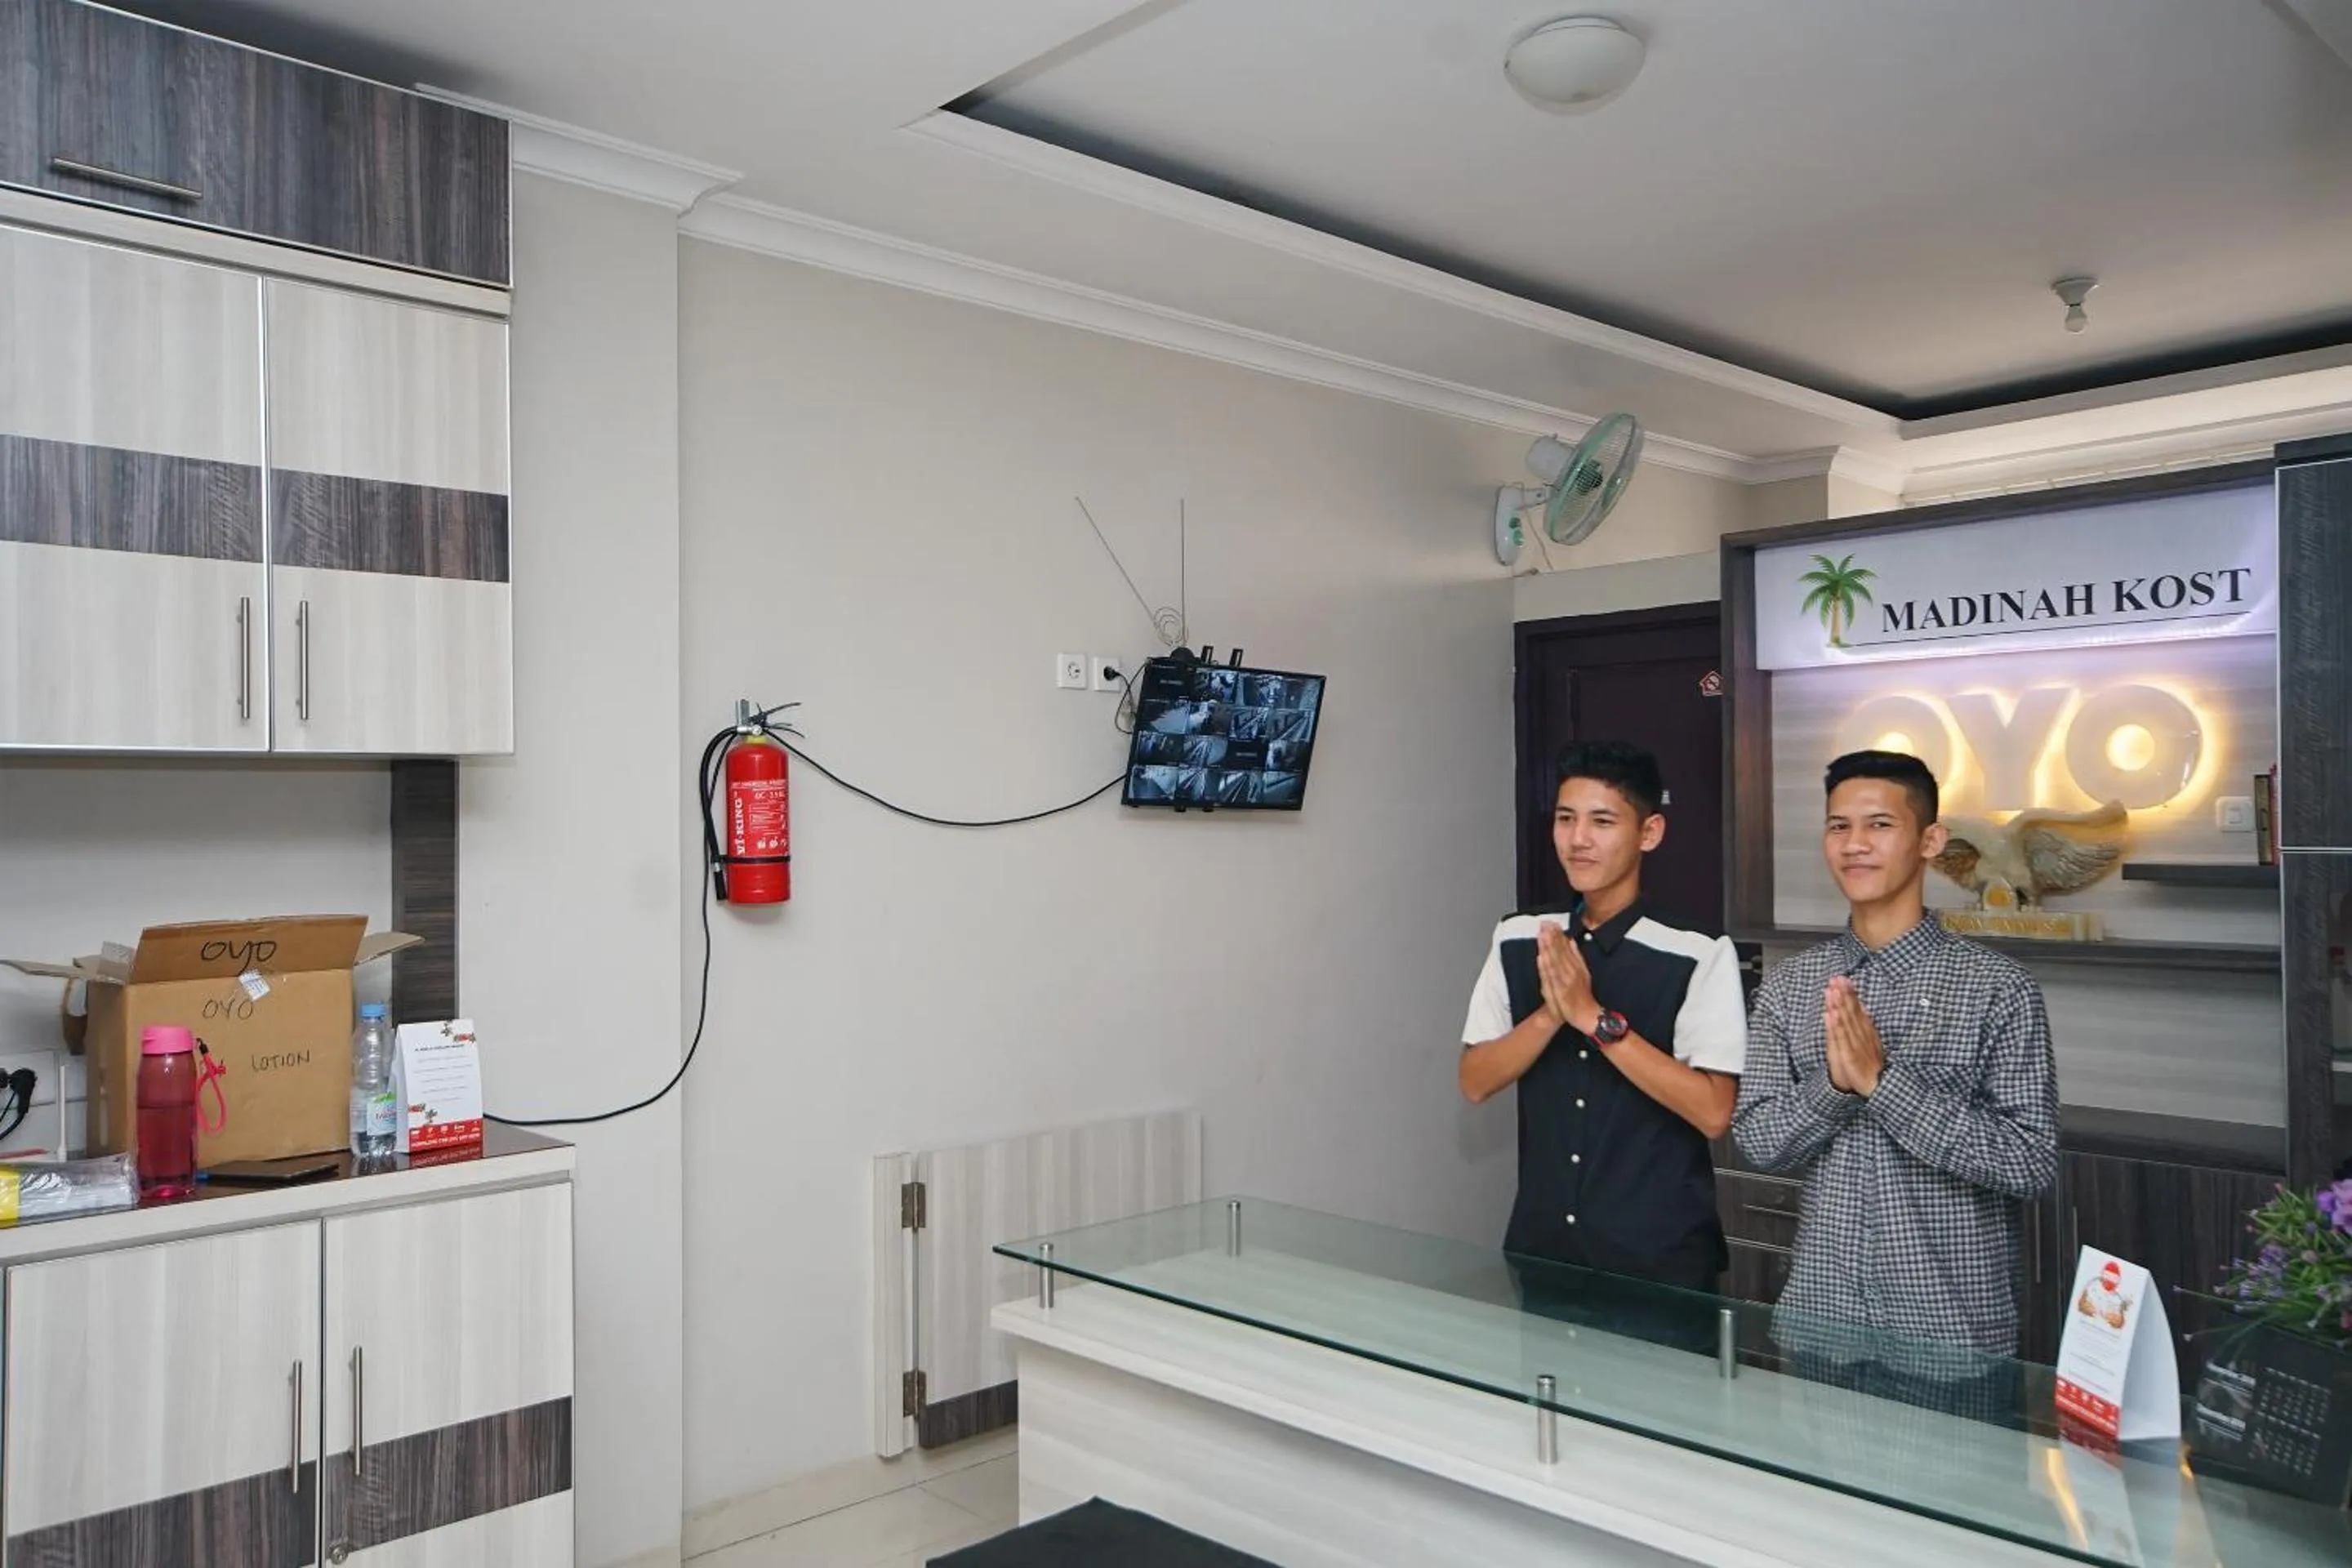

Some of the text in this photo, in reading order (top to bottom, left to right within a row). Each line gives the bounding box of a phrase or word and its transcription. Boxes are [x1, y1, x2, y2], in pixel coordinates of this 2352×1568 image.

[1881, 567, 2251, 633] MADINAH KOST
[1838, 684, 2203, 811] OYO
[202, 998, 254, 1020] OYO
[251, 1048, 311, 1072] LOTION
